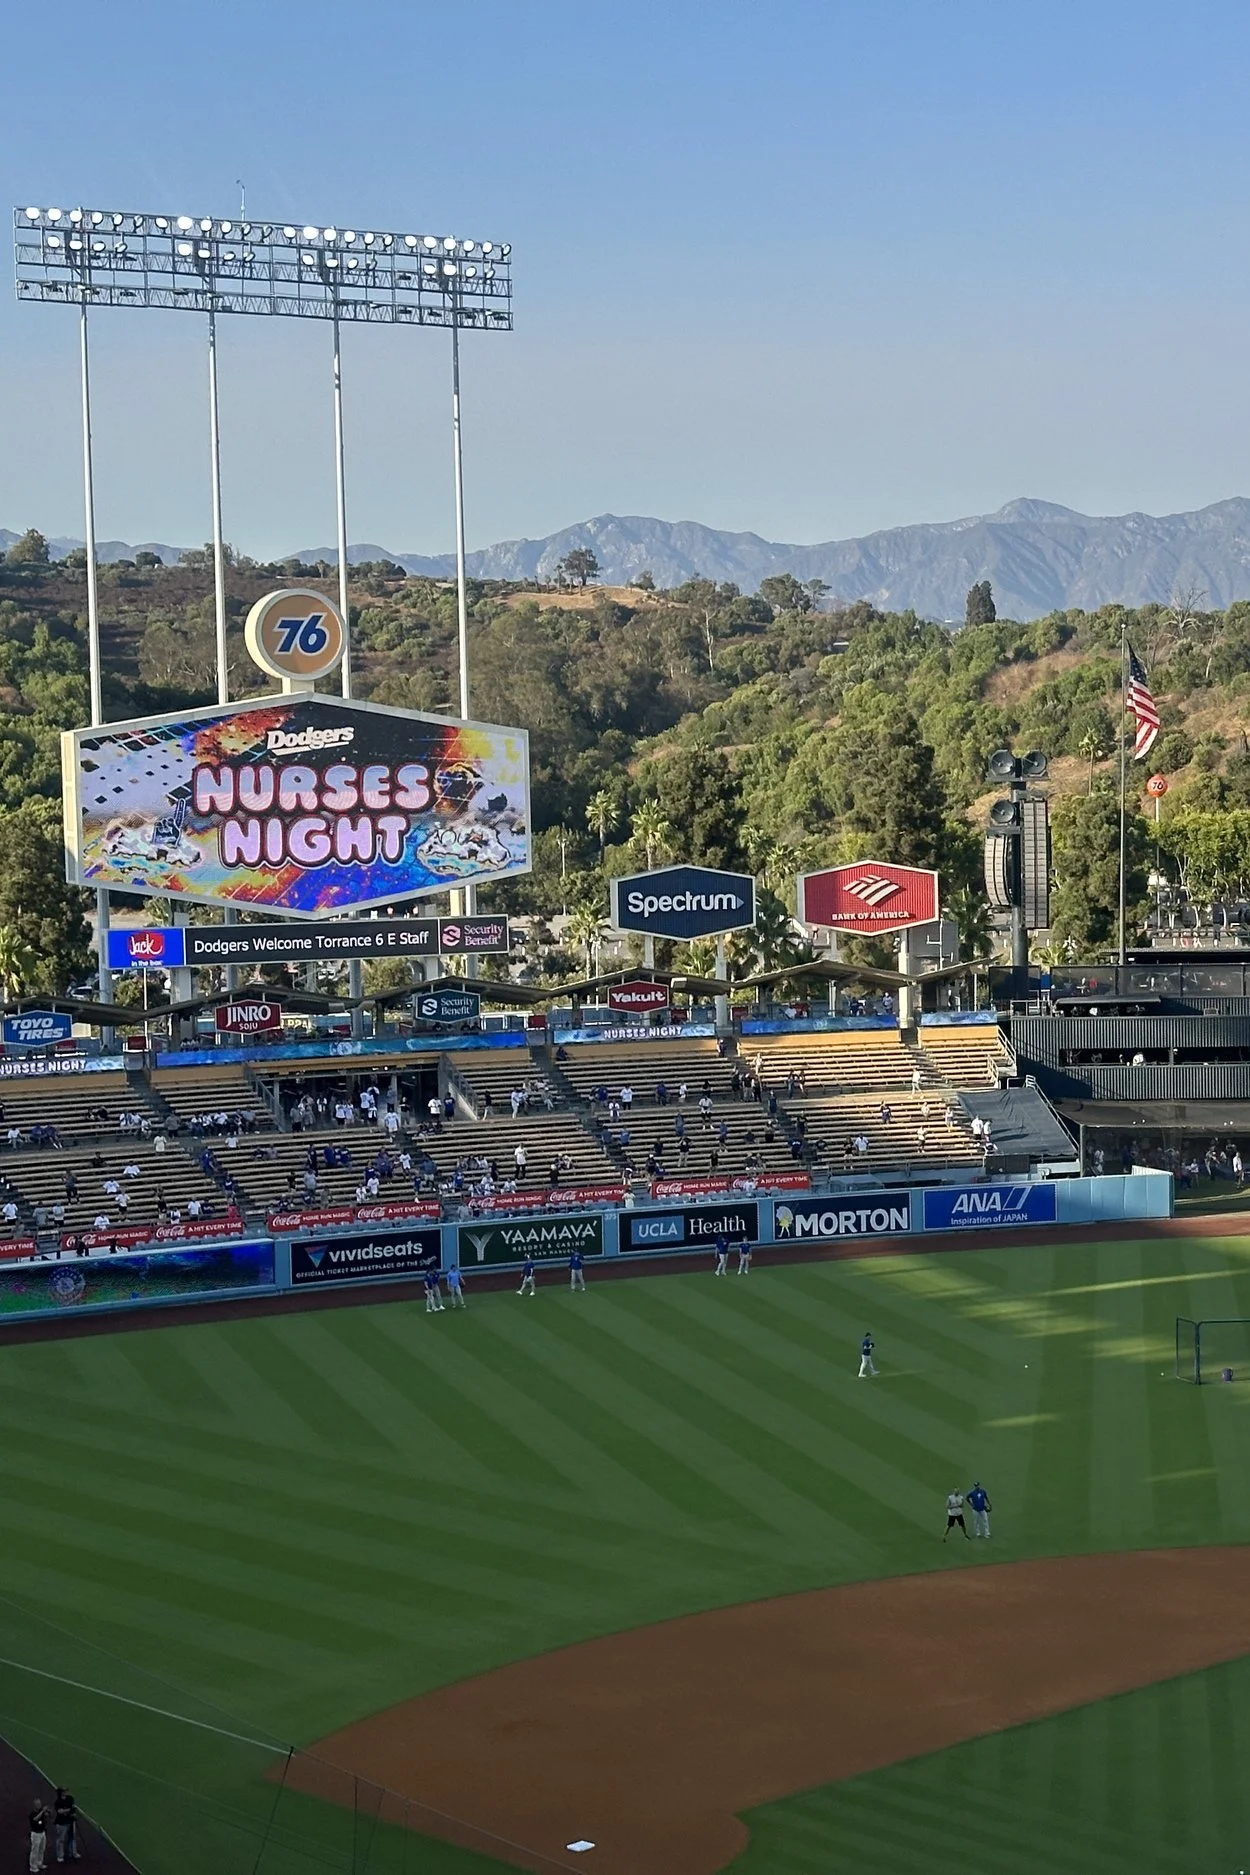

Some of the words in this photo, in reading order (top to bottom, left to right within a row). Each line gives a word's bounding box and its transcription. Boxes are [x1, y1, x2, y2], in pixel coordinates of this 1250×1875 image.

[273, 612, 330, 657] 76
[267, 726, 355, 750] Dodgers
[195, 764, 431, 812] NURSES
[1152, 781, 1164, 790] 76
[223, 815, 407, 865] NIGHT
[628, 890, 737, 918] Spectrum
[857, 912, 868, 920] OF
[870, 911, 910, 919] AMERICA
[464, 923, 504, 935] Security
[129, 933, 162, 955] Jack
[194, 939, 250, 955] Dodgers
[253, 936, 313, 951] Welcome
[315, 933, 372, 949] Torrance
[375, 933, 384, 945] 6
[388, 932, 396, 945] E
[400, 930, 430, 945] Staff
[465, 935, 499, 946] Benefit
[440, 997, 474, 1007] Security
[612, 991, 666, 1003] Yakult
[226, 1005, 271, 1027] JINRO
[441, 1006, 470, 1015] Benefit
[11, 1018, 53, 1030] TOYO
[239, 1022, 258, 1030] SOJU
[18, 1028, 65, 1040] TIRES
[604, 1027, 646, 1038] NURSES
[649, 1026, 681, 1037] NIGHT
[0, 1062, 45, 1075] NURSES
[48, 1060, 86, 1071] NIGHT
[951, 1191, 1002, 1214] ANA
[206, 1223, 225, 1231] EVERY
[689, 1215, 747, 1235] Health
[795, 1206, 909, 1237] MORTON
[950, 1216, 992, 1226] Inspiration
[993, 1215, 1002, 1223] of
[1003, 1213, 1028, 1222] JAPAN
[638, 1222, 678, 1238] UCLA
[329, 1240, 423, 1263] vividseats
[513, 1244, 543, 1252] RESORT
[556, 1240, 586, 1248] CASINO
[296, 1269, 325, 1278] OFFICIAL
[351, 1262, 395, 1273] MARKETPLACE
